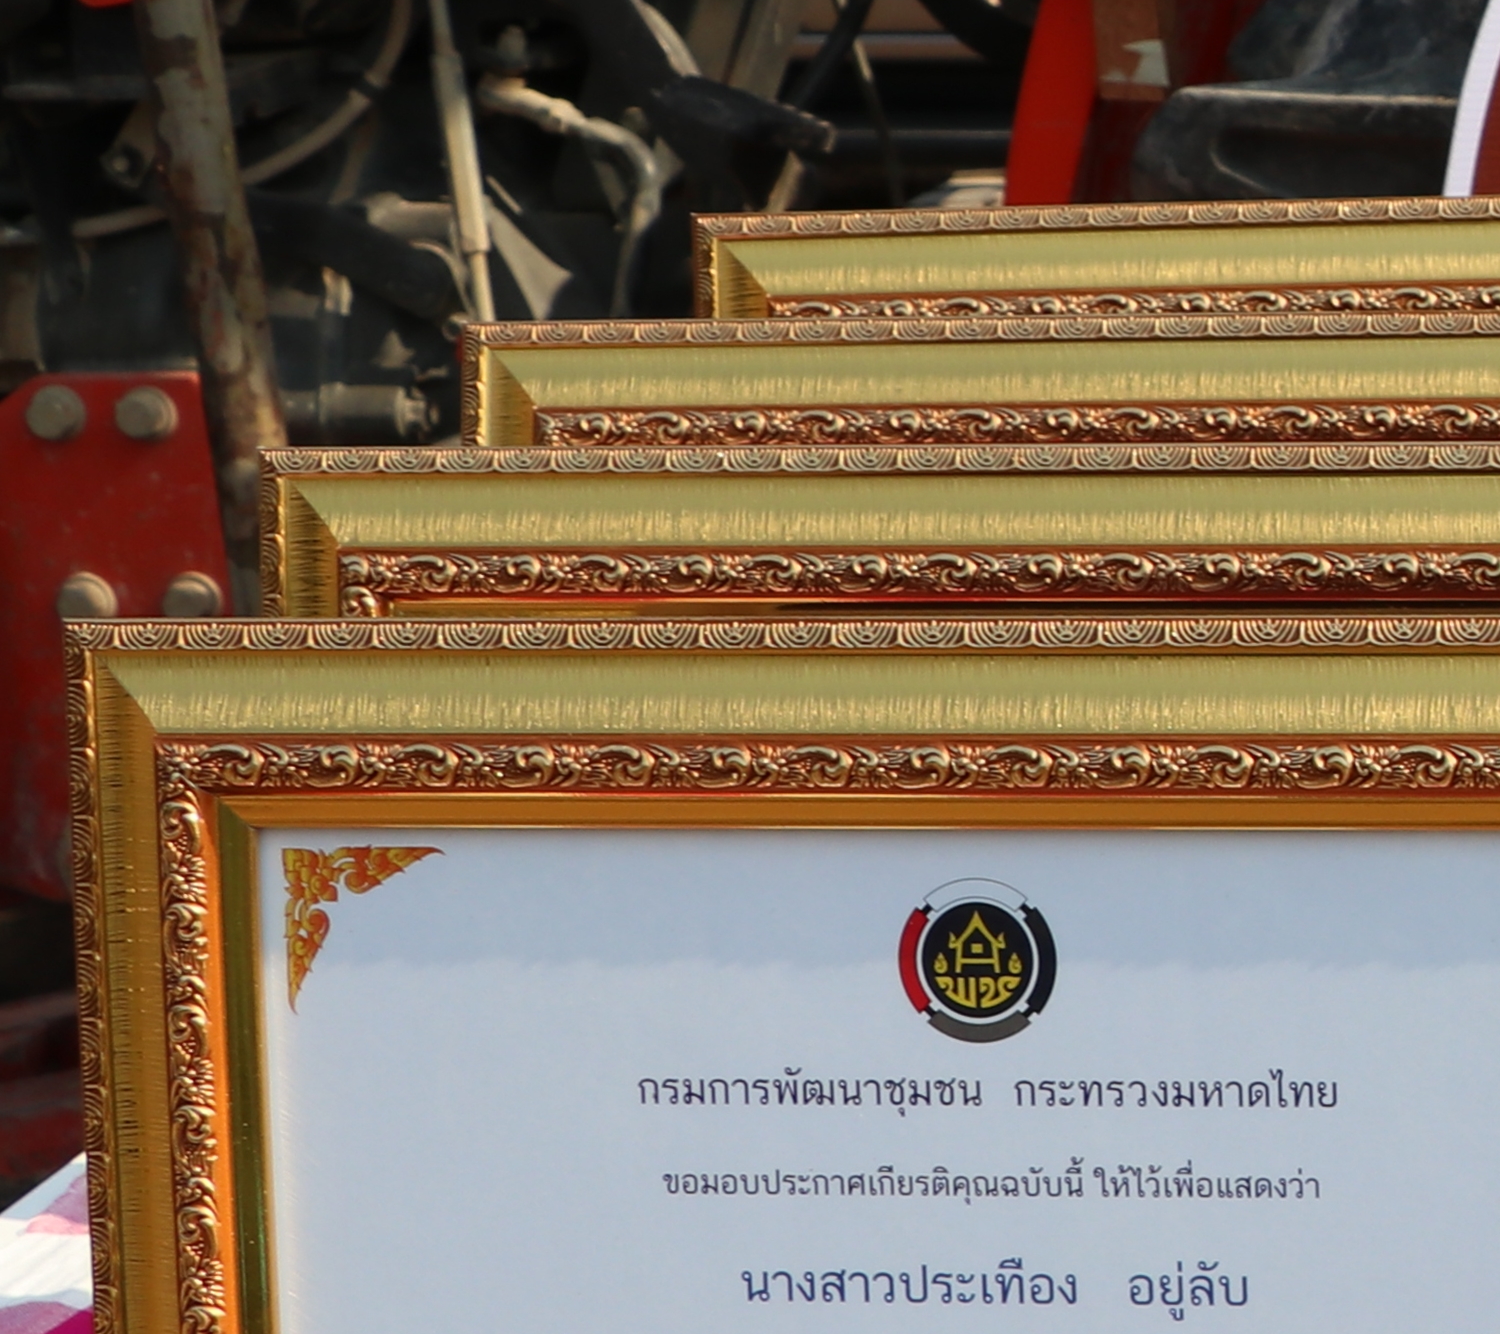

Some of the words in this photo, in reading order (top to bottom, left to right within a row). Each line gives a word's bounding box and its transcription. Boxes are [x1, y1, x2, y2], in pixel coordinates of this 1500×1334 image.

[637, 1066, 983, 1118] กรมการพัฒนาชุมชน
[1013, 1068, 1338, 1109] กระทรวงมหาดไทย
[1092, 1159, 1321, 1200] ให้ไว้เพื่อแสดงว่า
[740, 1257, 1078, 1305] นางสาวประเทือง
[1128, 1260, 1249, 1322] อยู่ลับ
